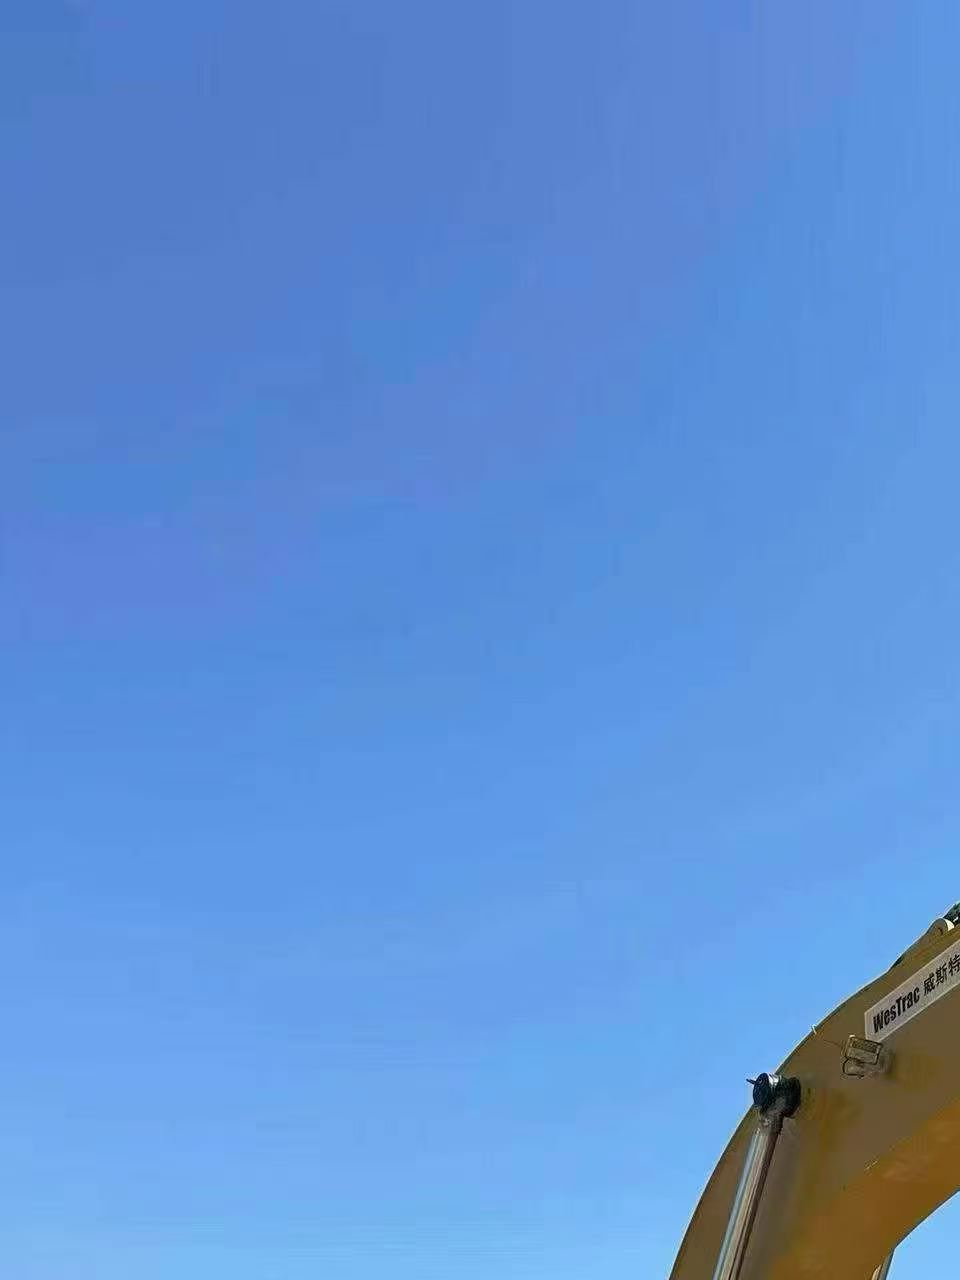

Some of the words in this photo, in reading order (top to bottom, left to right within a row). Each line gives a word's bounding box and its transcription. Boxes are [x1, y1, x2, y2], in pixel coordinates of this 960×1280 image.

[873, 987, 920, 1033] WesTrac
[923, 954, 960, 996] 威斯特
